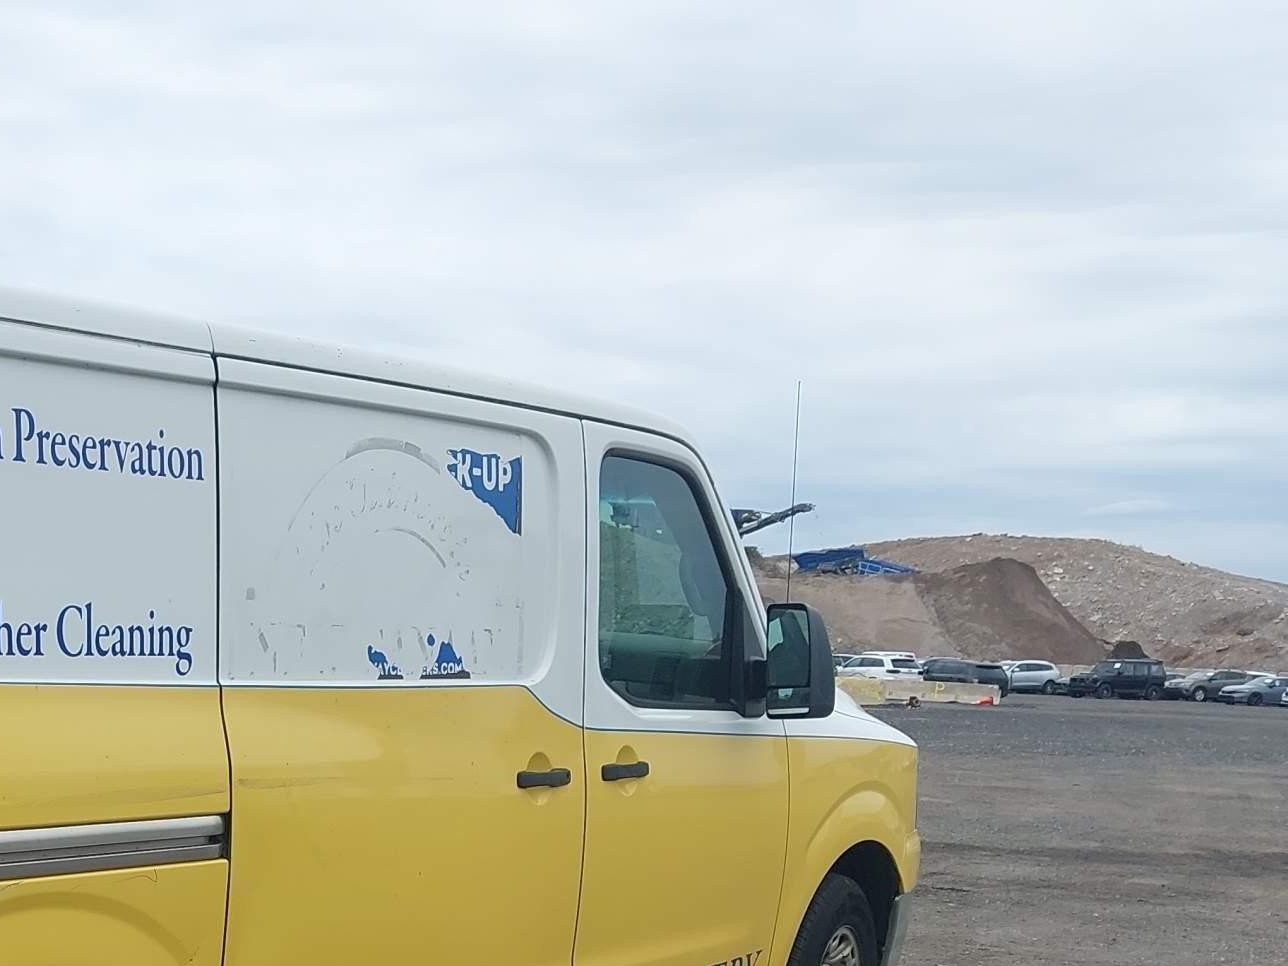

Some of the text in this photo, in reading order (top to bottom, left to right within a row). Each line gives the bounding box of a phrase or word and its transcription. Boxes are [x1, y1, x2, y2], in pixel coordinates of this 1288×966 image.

[11, 408, 205, 481] Preservation
[447, 450, 512, 492] K-UP
[56, 602, 194, 677] Cleaning
